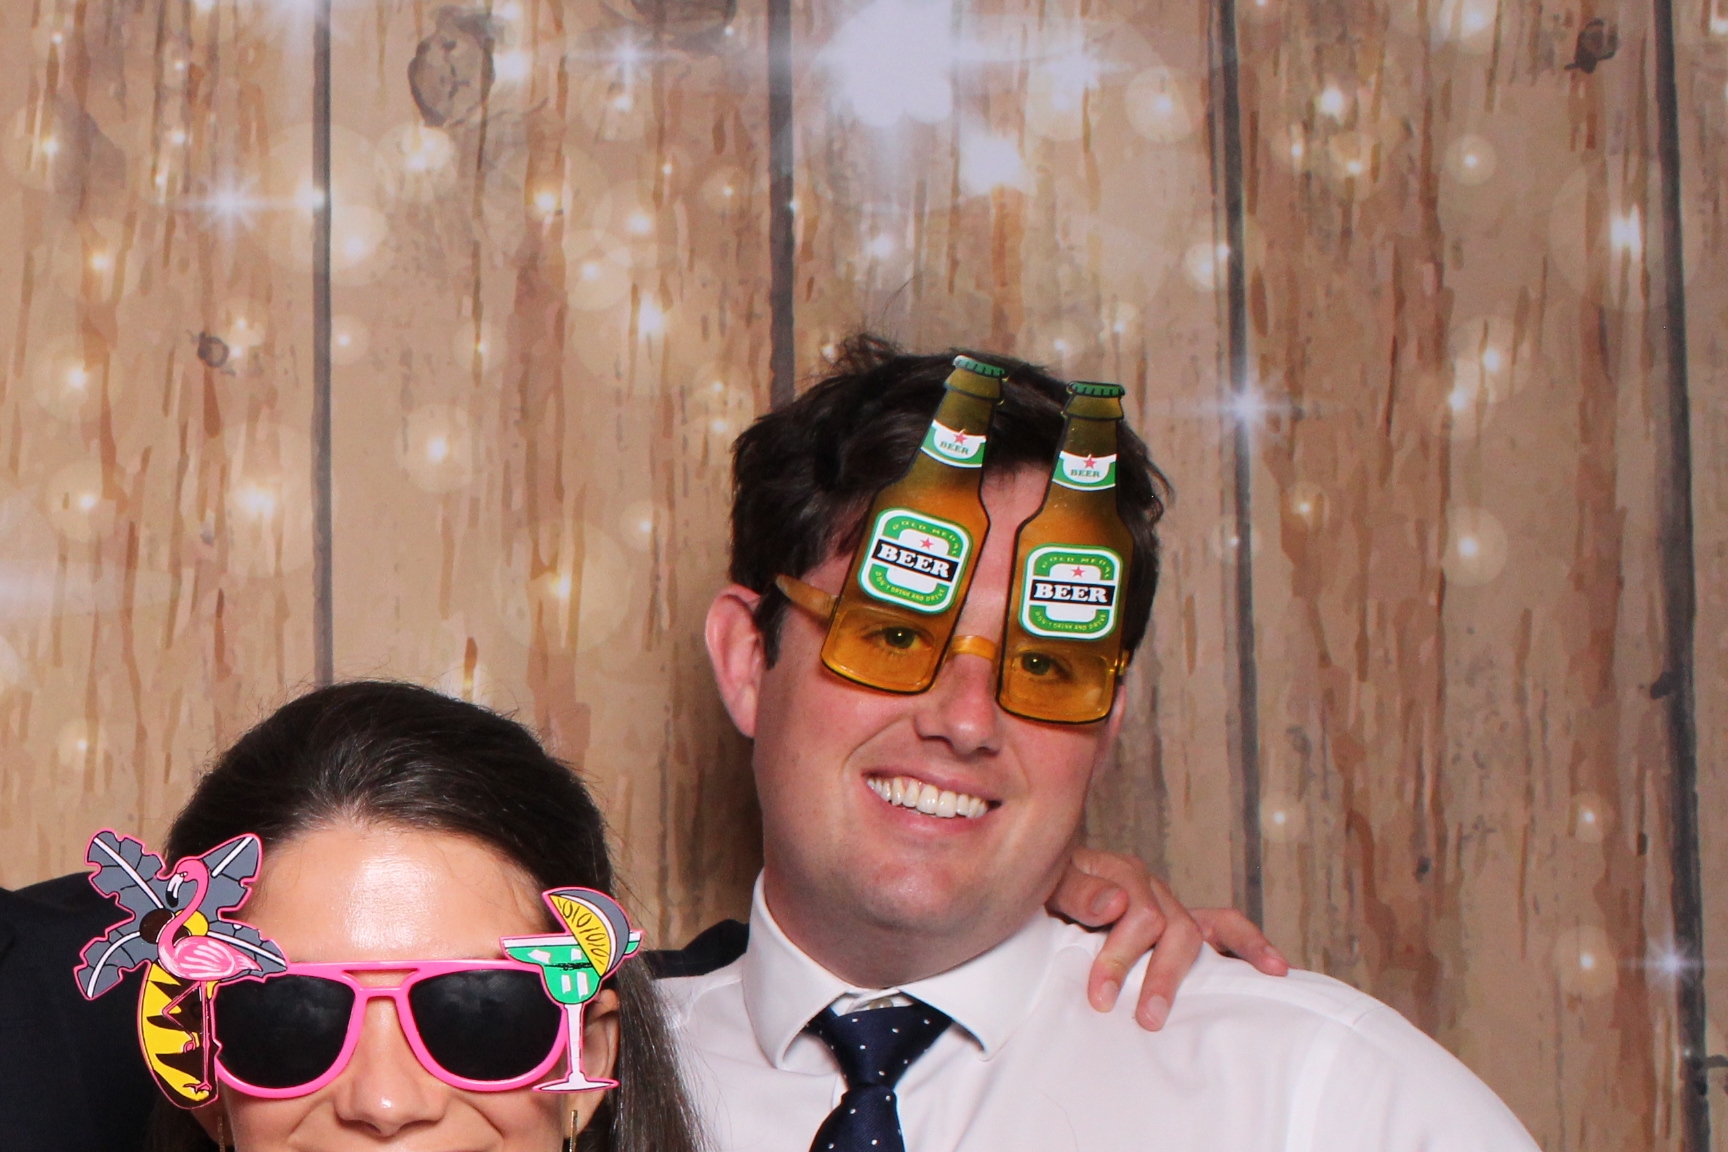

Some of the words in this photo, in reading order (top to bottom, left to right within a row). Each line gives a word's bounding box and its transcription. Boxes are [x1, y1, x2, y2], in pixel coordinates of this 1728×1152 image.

[940, 441, 969, 455] BEER
[1070, 469, 1100, 478] BEER
[876, 543, 950, 578] BEER
[1033, 582, 1108, 603] BEER
